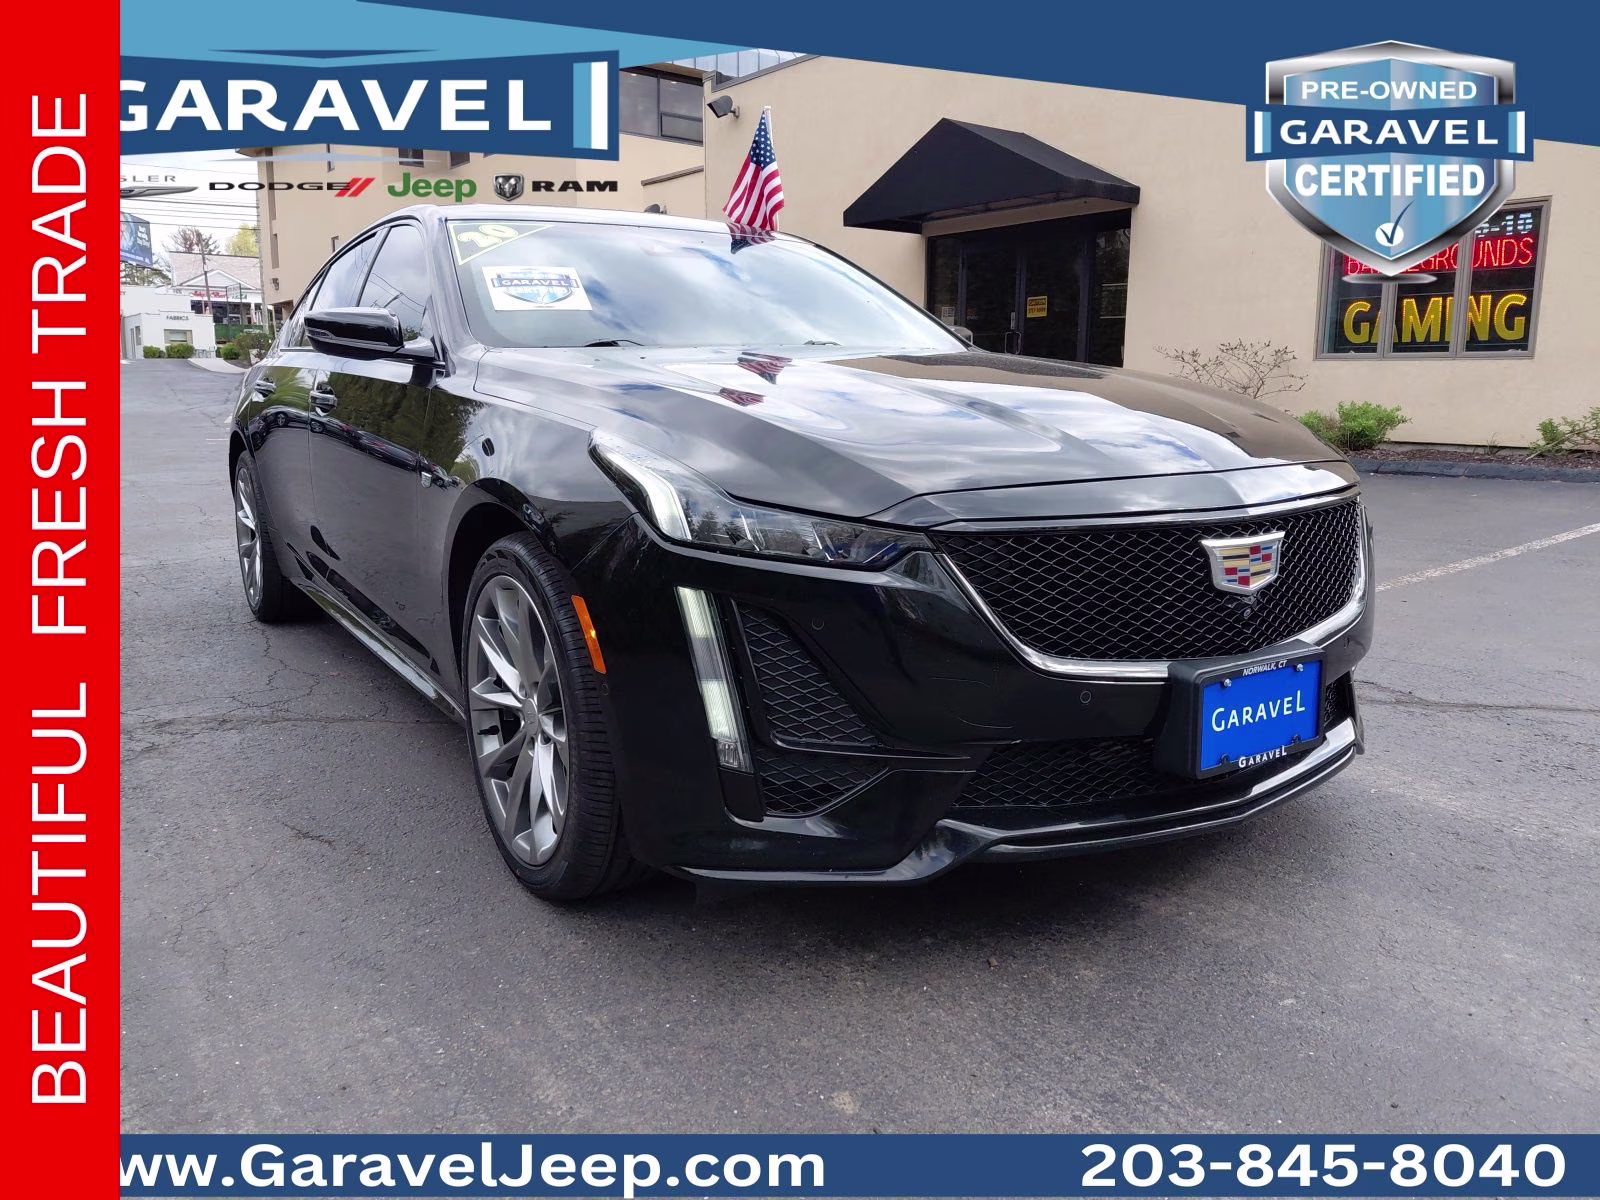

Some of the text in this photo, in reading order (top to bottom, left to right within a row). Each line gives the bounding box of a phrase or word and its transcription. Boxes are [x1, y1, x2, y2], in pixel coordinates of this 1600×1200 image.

[457, 224, 519, 248] 20
[1278, 659, 1288, 669] CT
[1211, 689, 1306, 732] GARAVEL
[1238, 745, 1287, 768] GARAVEL
